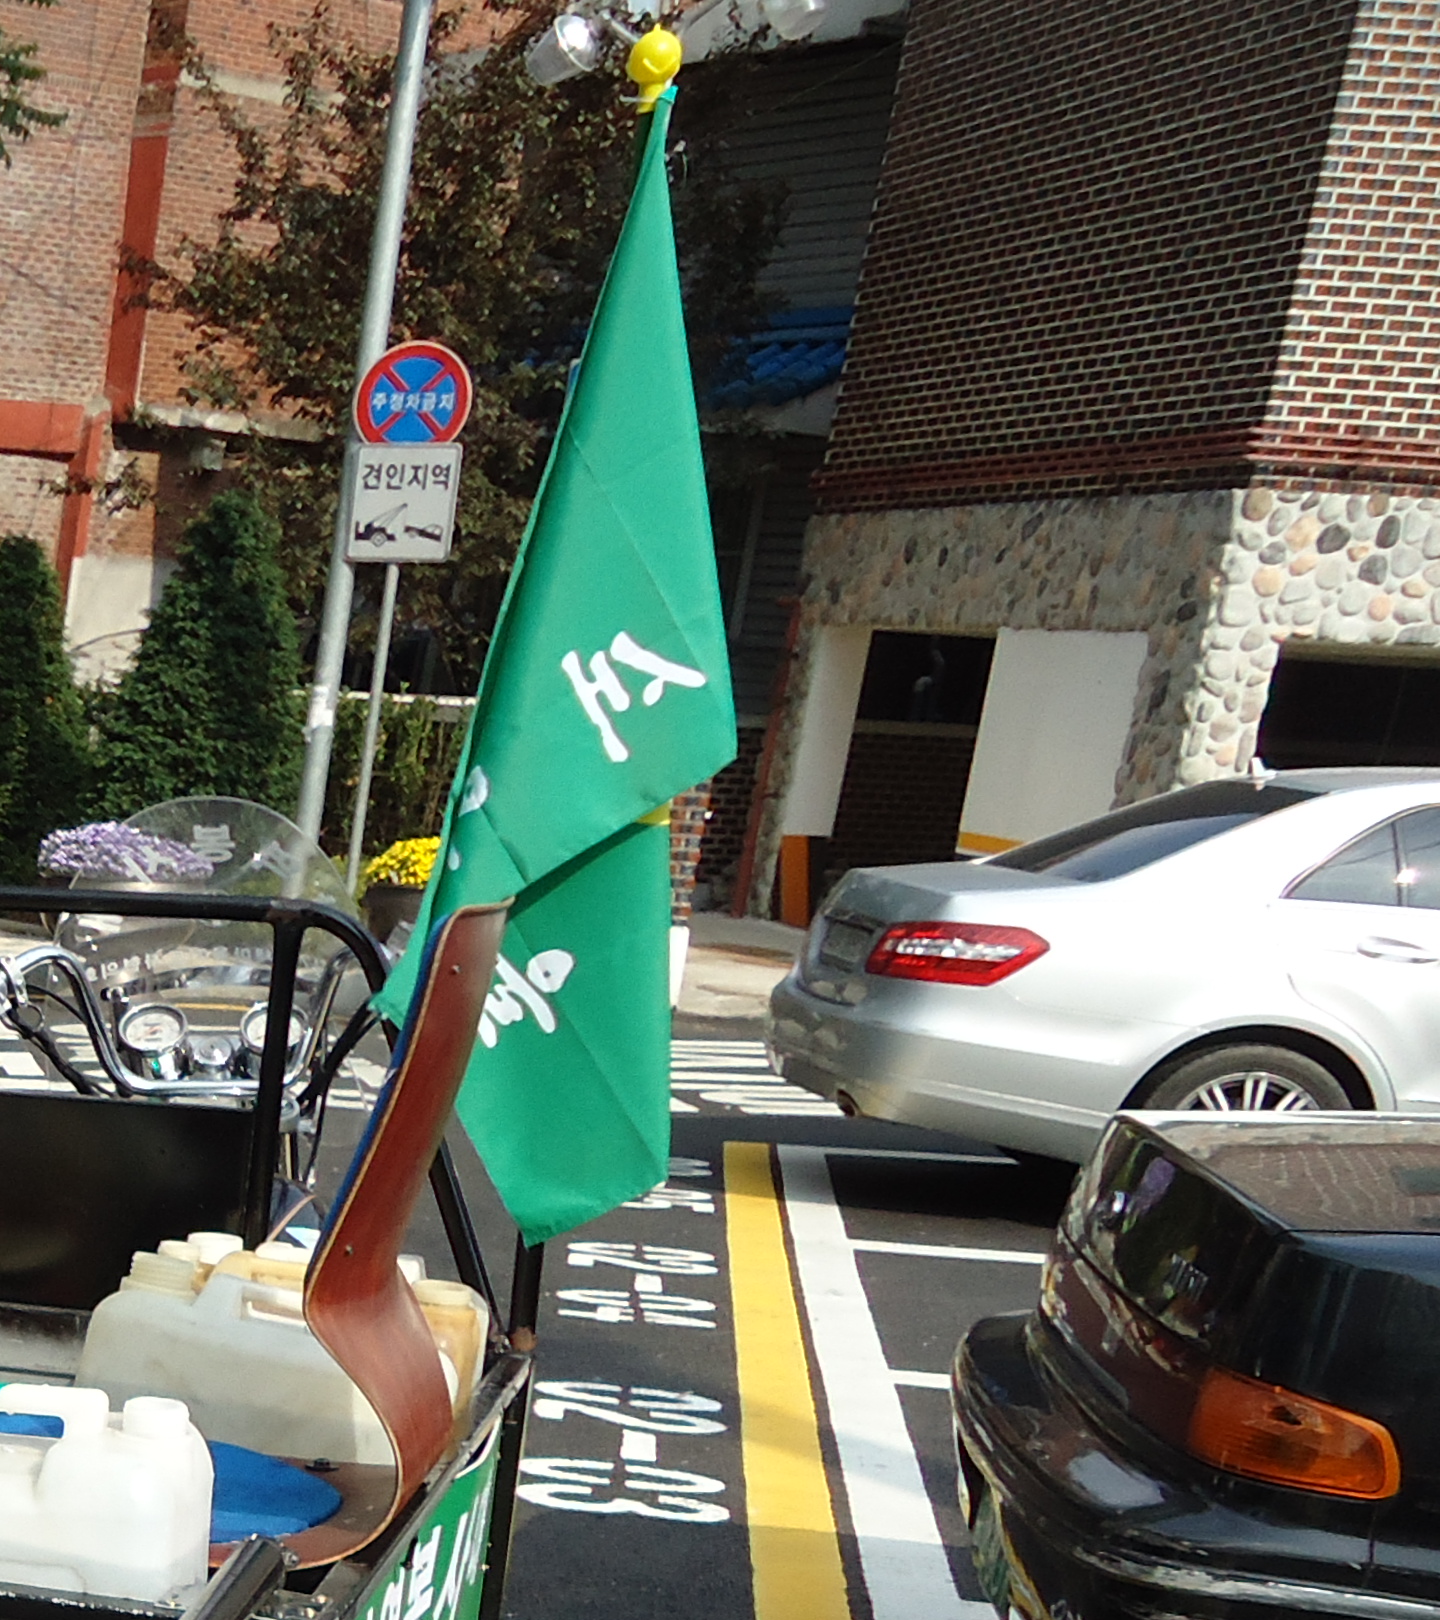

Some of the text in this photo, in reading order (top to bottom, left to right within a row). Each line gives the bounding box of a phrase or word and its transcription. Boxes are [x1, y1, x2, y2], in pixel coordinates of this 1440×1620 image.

[372, 391, 455, 412] 주정차금지
[362, 463, 451, 490] 견인지역
[516, 1380, 731, 1523] 02-03
